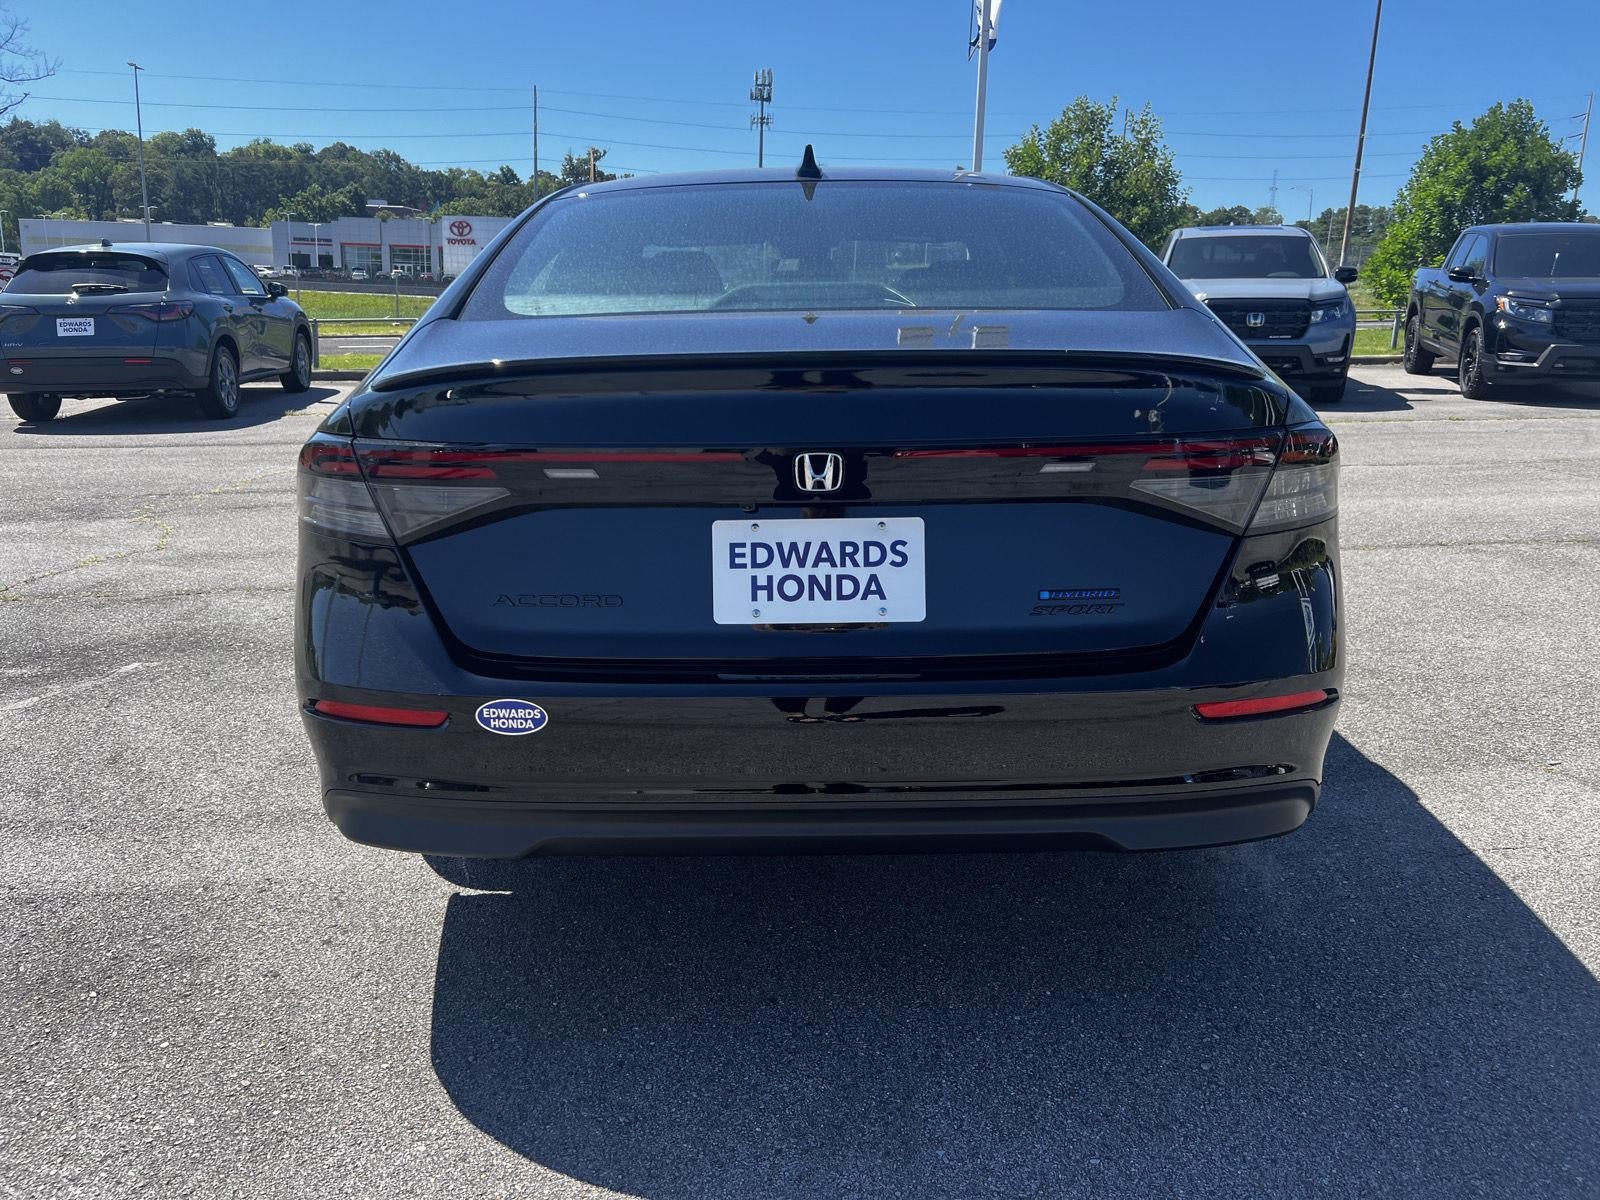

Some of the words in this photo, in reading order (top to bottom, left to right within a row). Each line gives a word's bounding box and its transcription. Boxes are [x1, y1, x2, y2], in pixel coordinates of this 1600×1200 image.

[728, 539, 909, 570] EDWARDS
[750, 573, 888, 603] HONDA
[1050, 590, 1118, 599] HYBRID
[492, 594, 624, 608] ACCORD
[1029, 603, 1125, 616] SPORT
[483, 708, 541, 719] EDWARDS
[490, 718, 535, 729] HONDA
